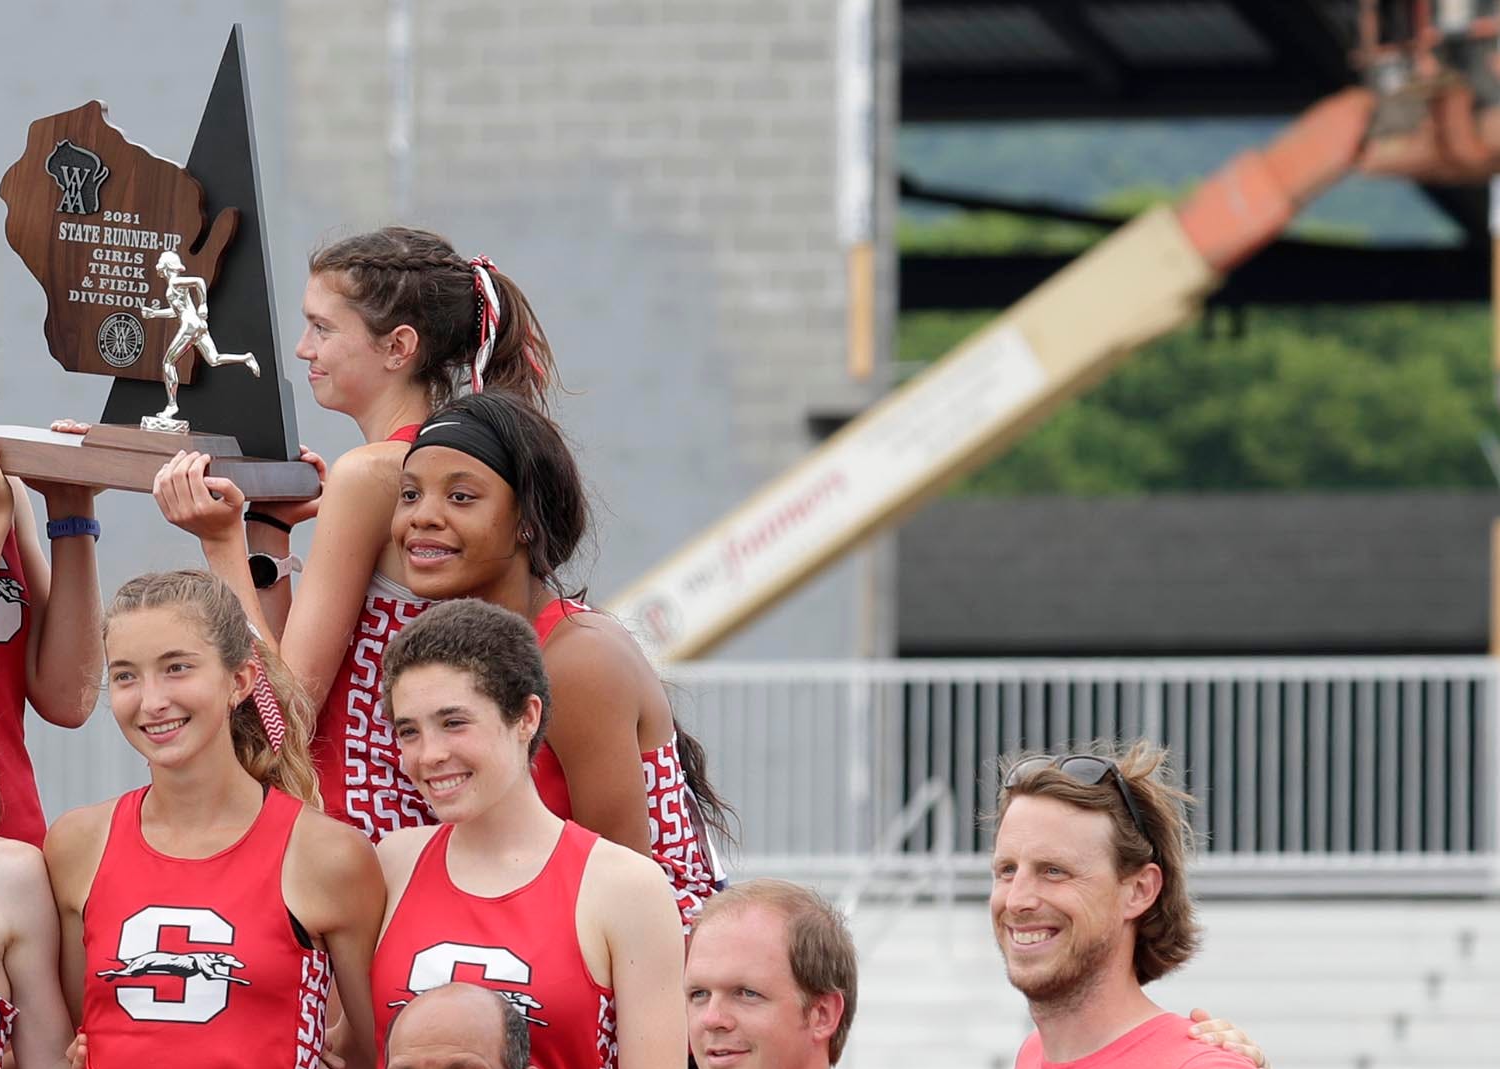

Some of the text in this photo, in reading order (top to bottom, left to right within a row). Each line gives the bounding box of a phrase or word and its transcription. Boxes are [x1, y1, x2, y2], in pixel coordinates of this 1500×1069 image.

[103, 211, 140, 224] 2021
[59, 222, 181, 251] STATE RUNNER-UP
[92, 248, 144, 264] GIRLS
[88, 262, 145, 279] TRACK
[81, 276, 149, 293] & FIELD
[68, 290, 161, 309] DIVISION 2
[115, 905, 236, 1024] S
